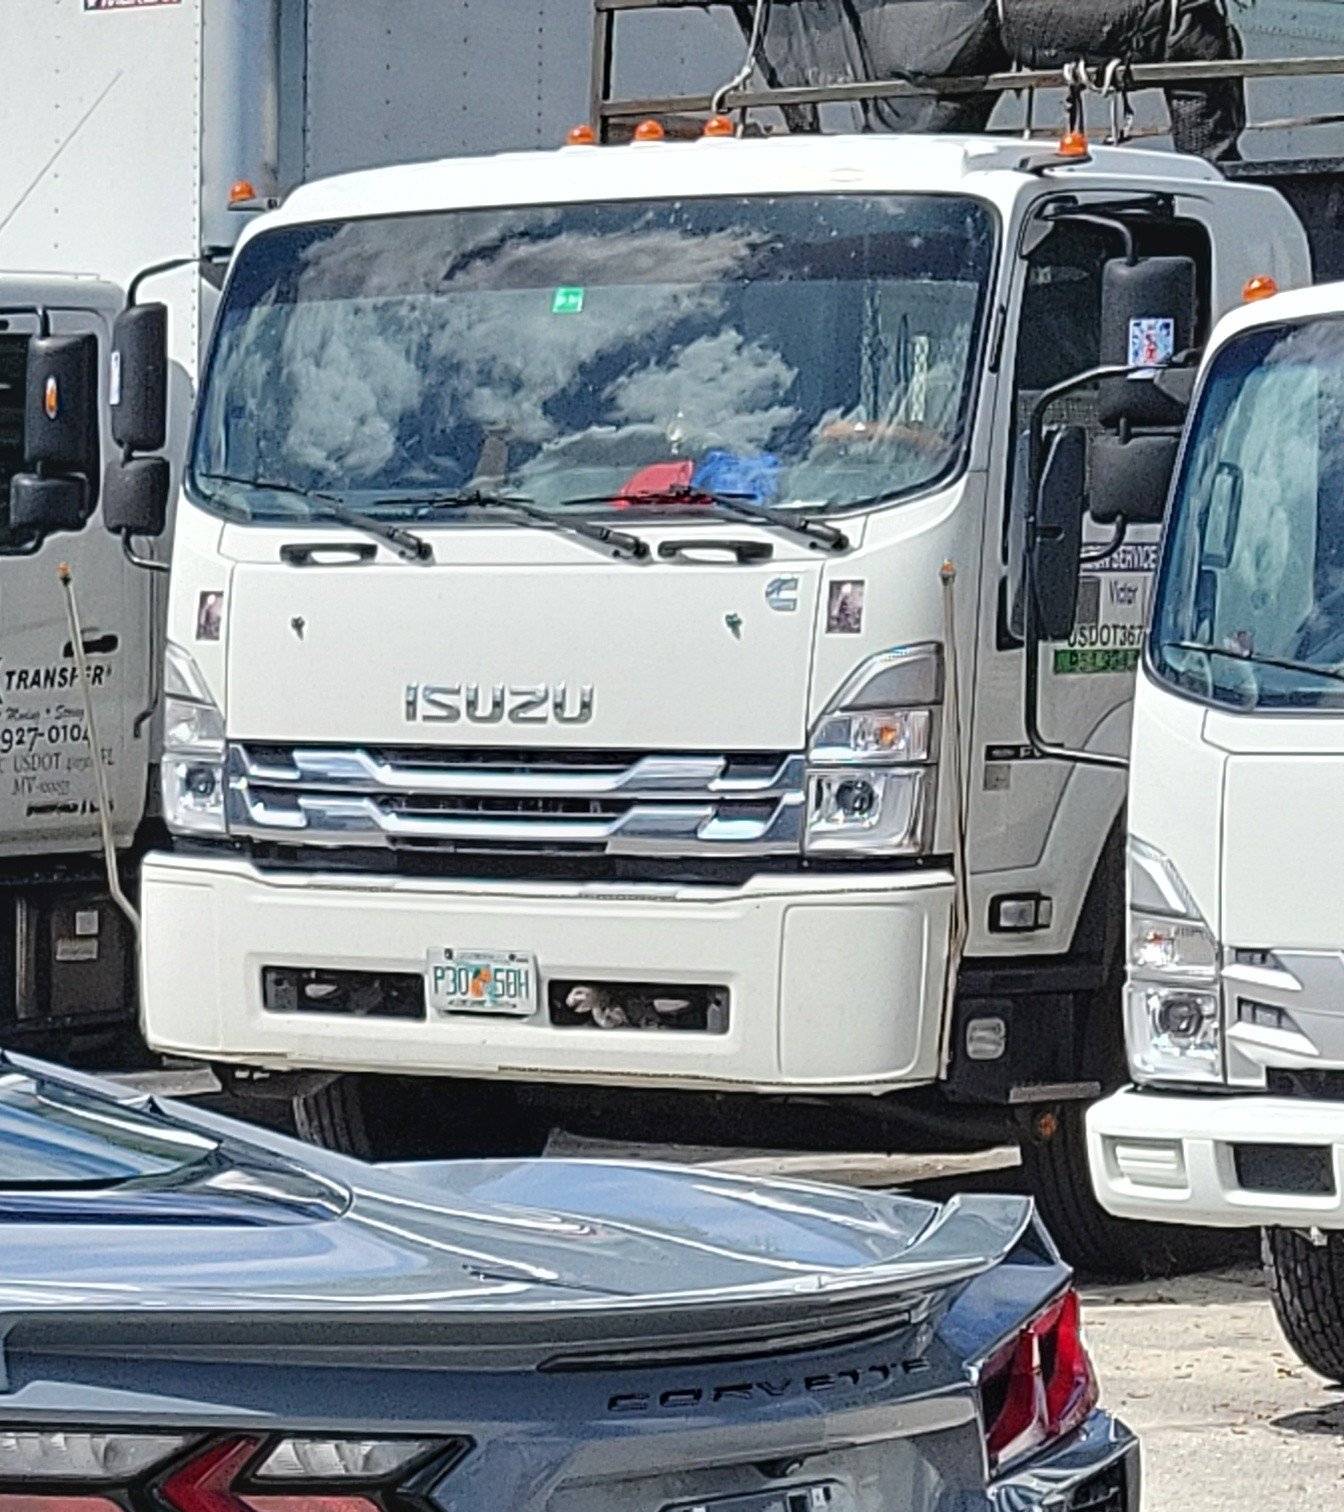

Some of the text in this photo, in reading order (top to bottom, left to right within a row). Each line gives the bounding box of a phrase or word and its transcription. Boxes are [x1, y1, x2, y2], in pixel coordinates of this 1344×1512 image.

[406, 683, 594, 724] ISUZU
[433, 965, 470, 996] P30
[607, 1357, 931, 1413] CORVETTE
